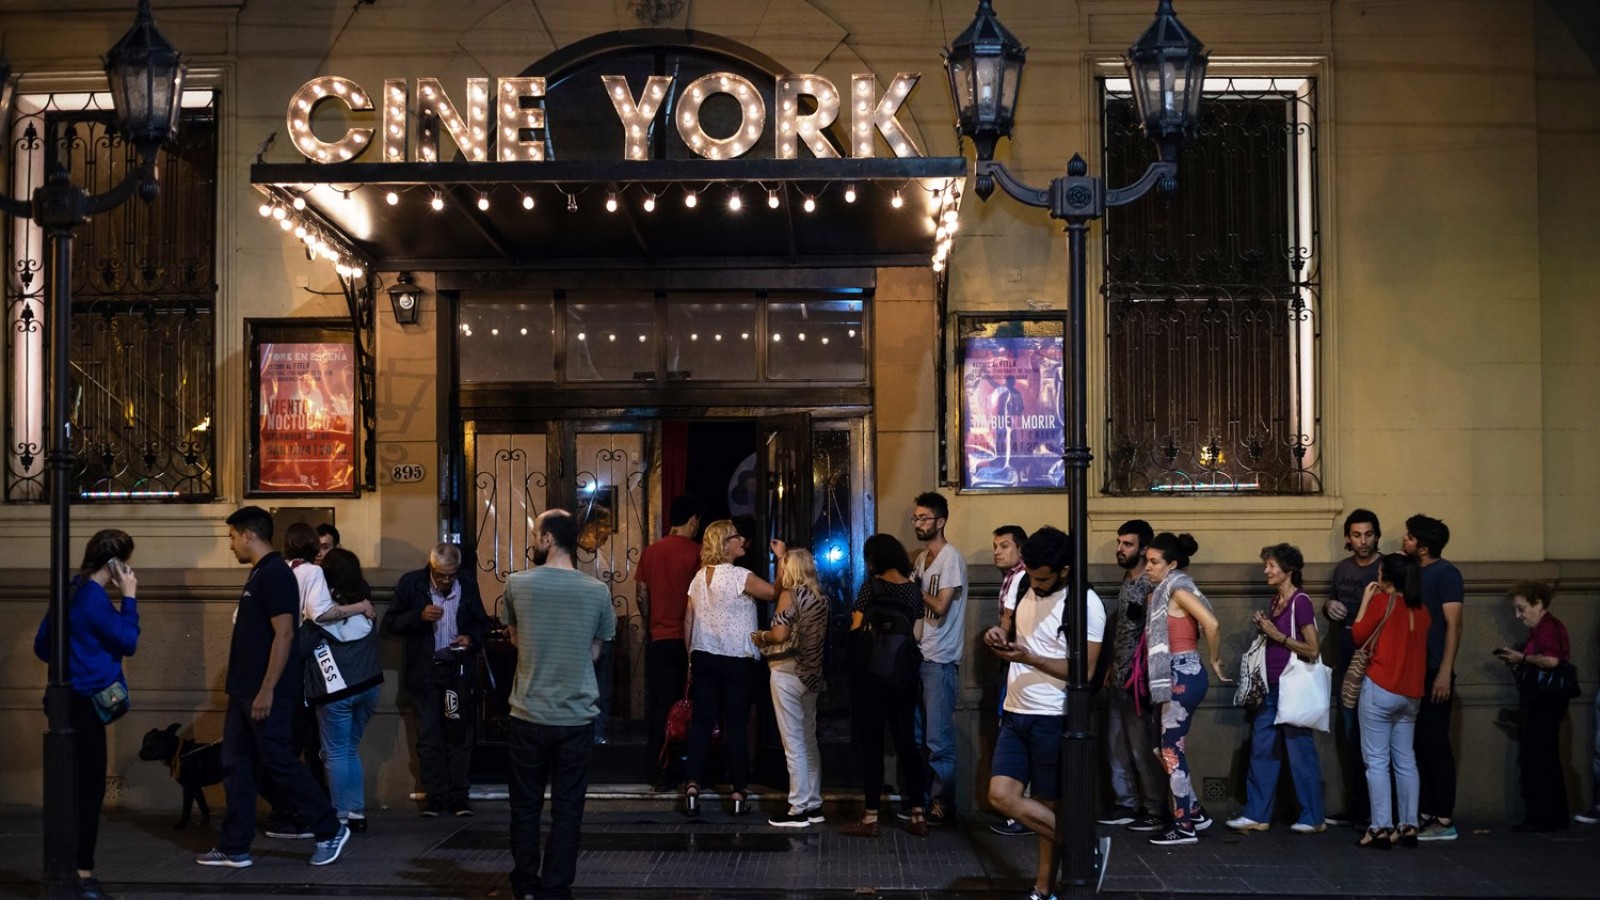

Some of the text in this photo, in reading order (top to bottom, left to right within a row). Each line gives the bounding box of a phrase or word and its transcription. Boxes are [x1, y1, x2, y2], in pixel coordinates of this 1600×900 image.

[287, 72, 924, 163] CINE YORK
[294, 352, 308, 361] EN
[310, 352, 347, 361] ESCENA
[991, 415, 1018, 429] BUEN
[1021, 415, 1056, 429] MORIR
[393, 465, 422, 480] 895
[315, 643, 337, 682] GUESS
